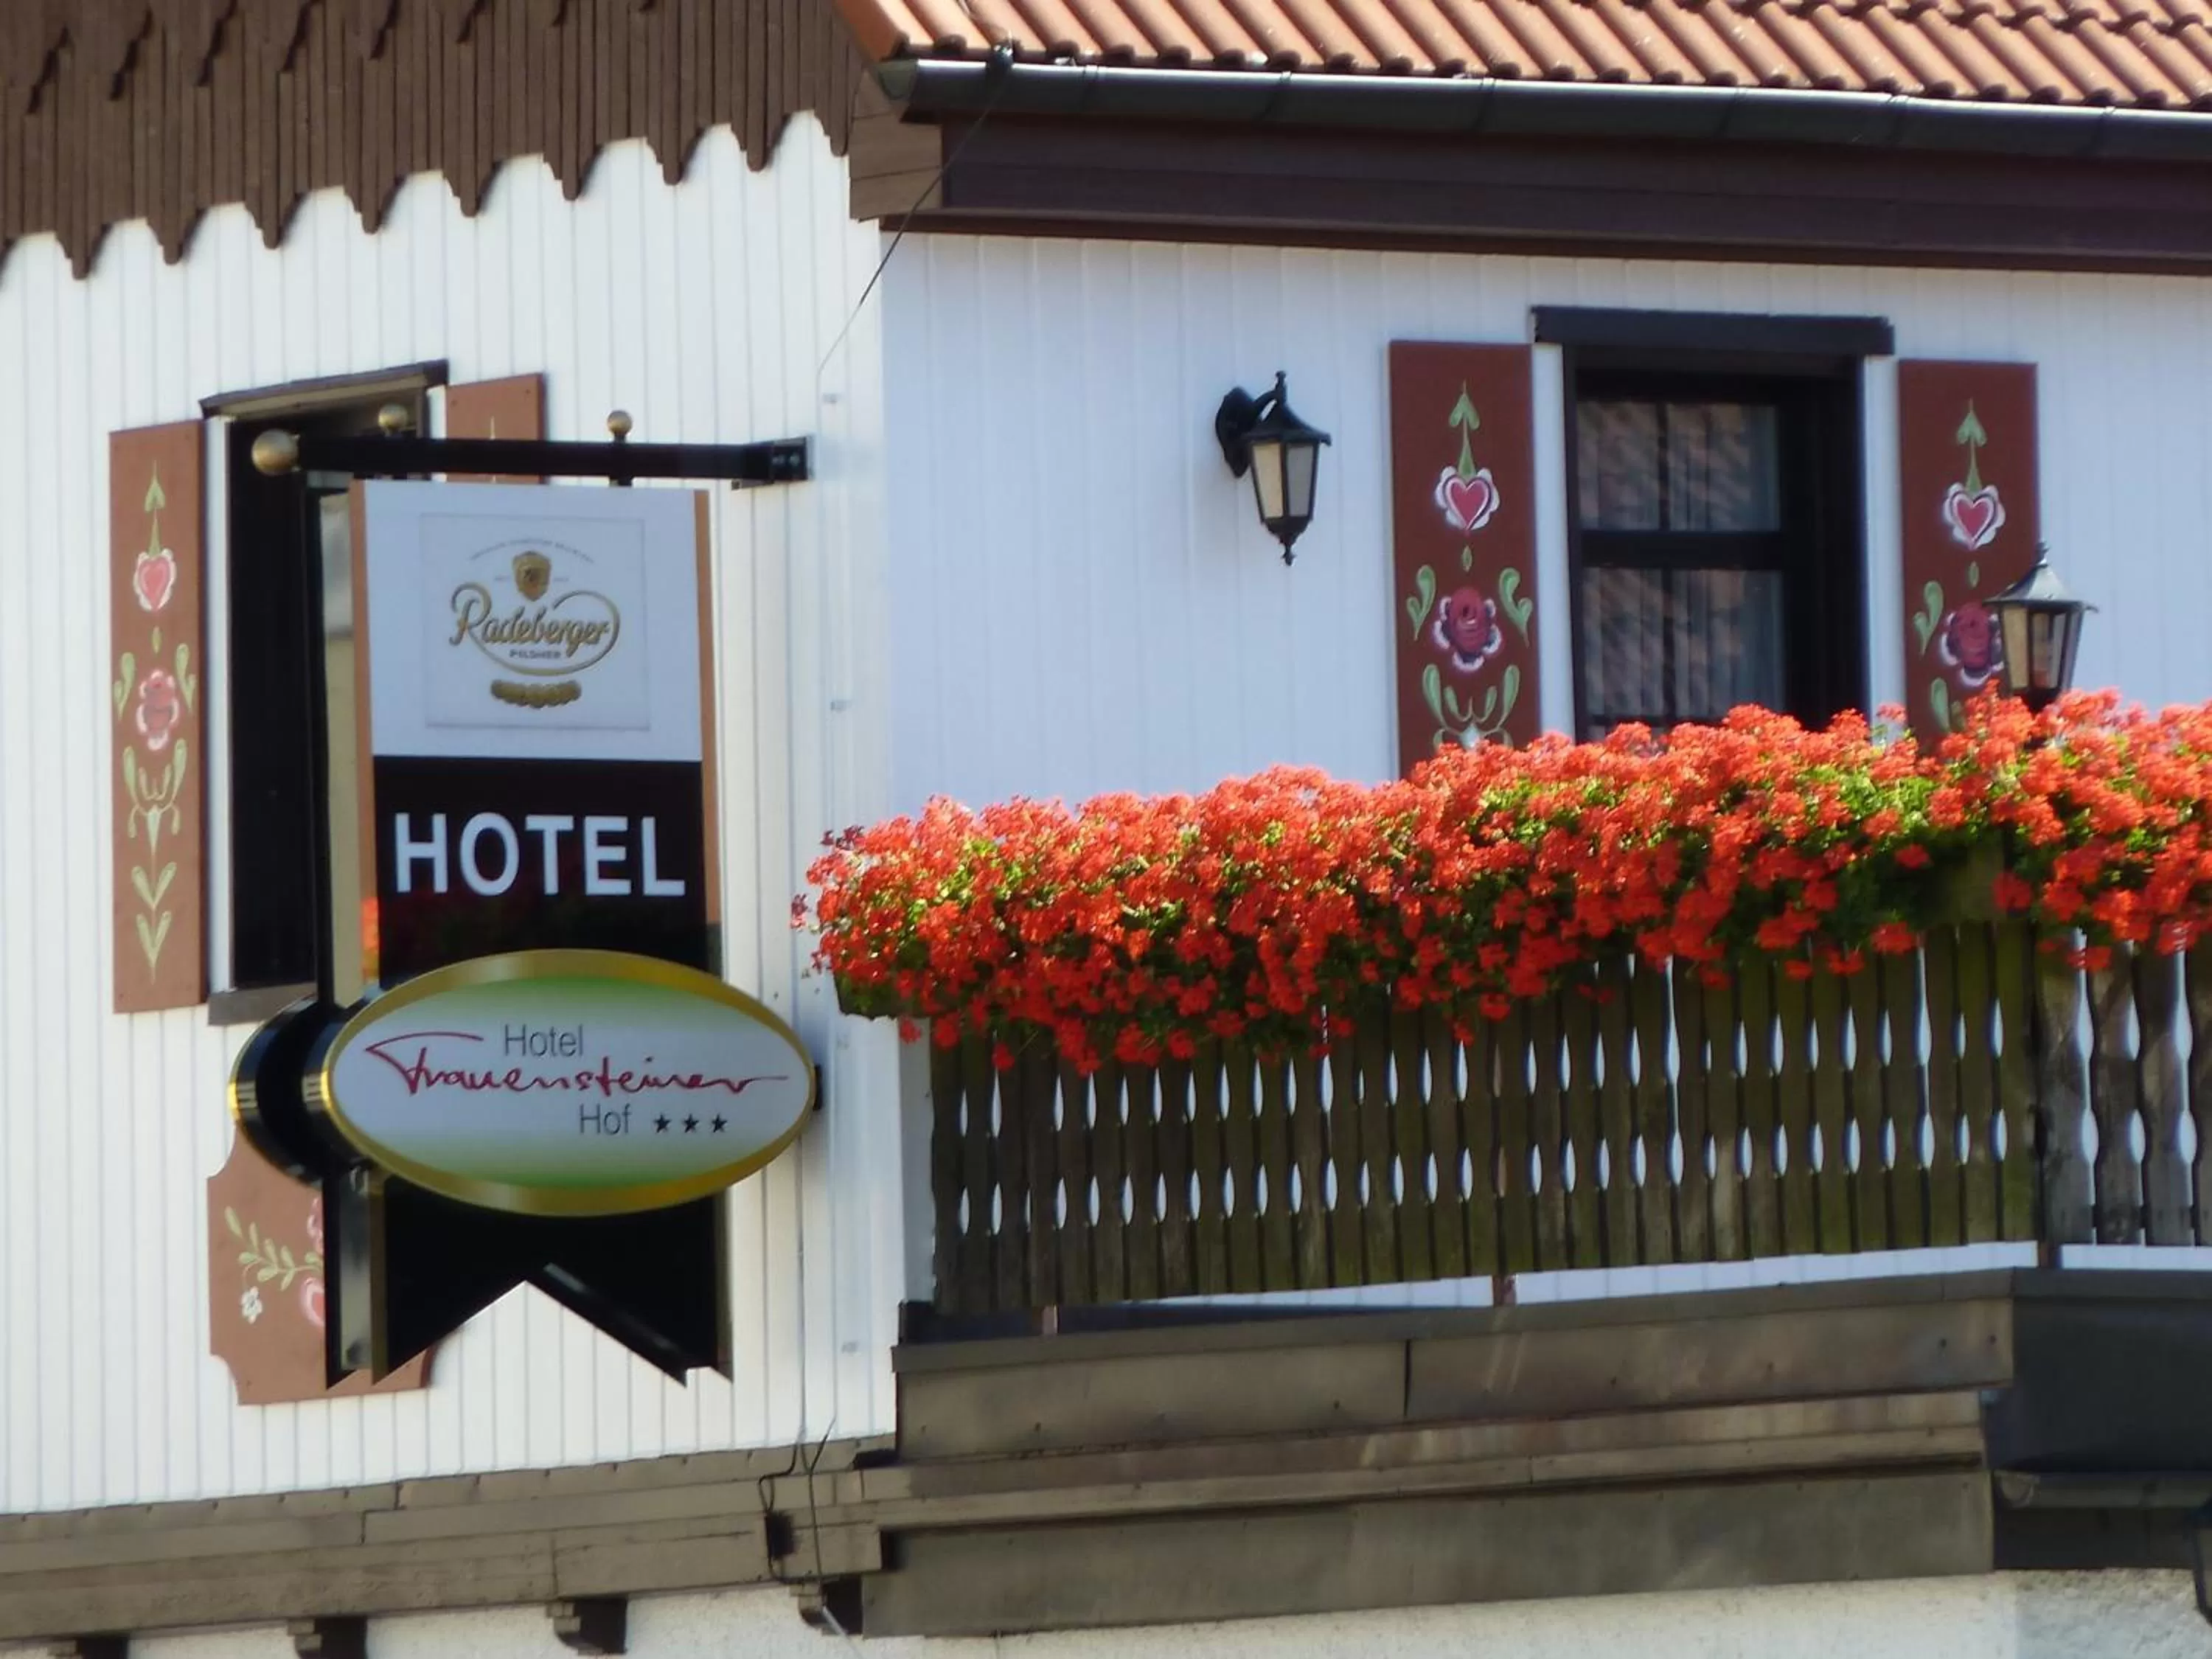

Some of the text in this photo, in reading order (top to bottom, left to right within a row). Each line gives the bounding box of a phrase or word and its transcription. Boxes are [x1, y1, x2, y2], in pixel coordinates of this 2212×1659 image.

[449, 582, 613, 658] Radeberger
[394, 812, 686, 897] HOTEL
[504, 1023, 584, 1057] Hotel
[580, 1103, 633, 1135] Hof
